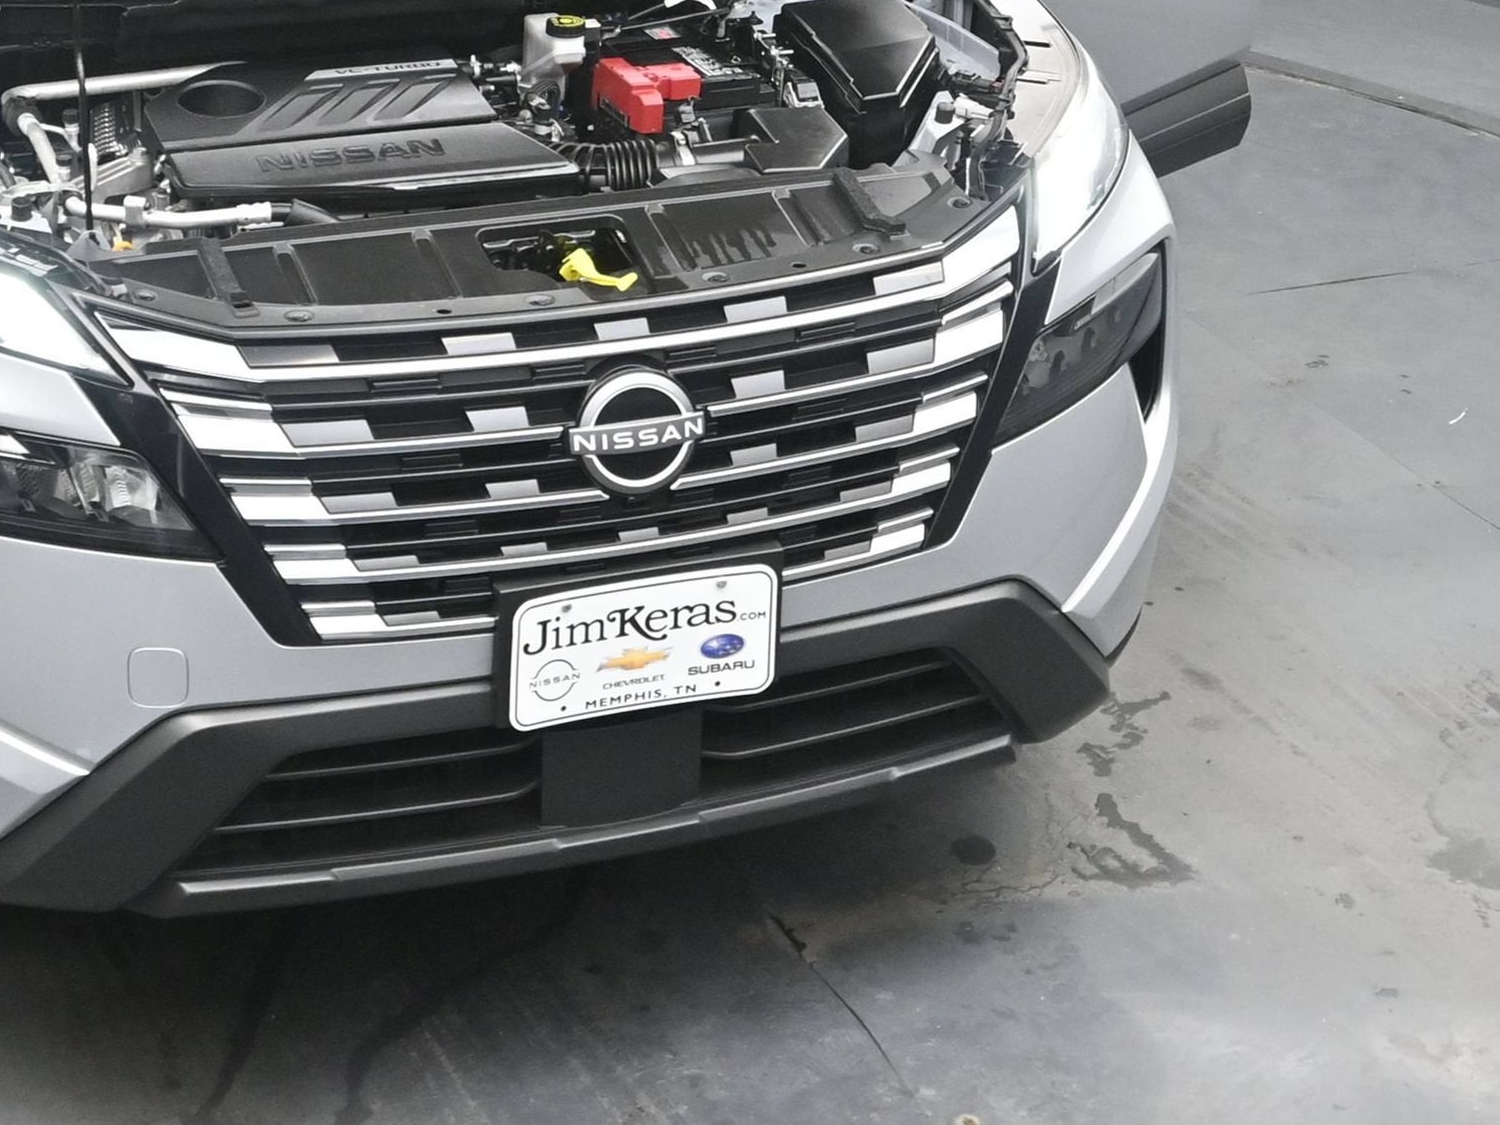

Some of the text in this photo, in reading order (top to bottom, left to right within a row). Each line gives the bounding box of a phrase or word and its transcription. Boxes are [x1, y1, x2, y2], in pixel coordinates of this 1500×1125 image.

[257, 138, 446, 173] NISSAN
[573, 418, 703, 451] NISSAN
[687, 659, 755, 675] SUBARU
[529, 672, 581, 688] NISSAN
[602, 674, 665, 690] CHEVROLET
[673, 684, 697, 695] TN
